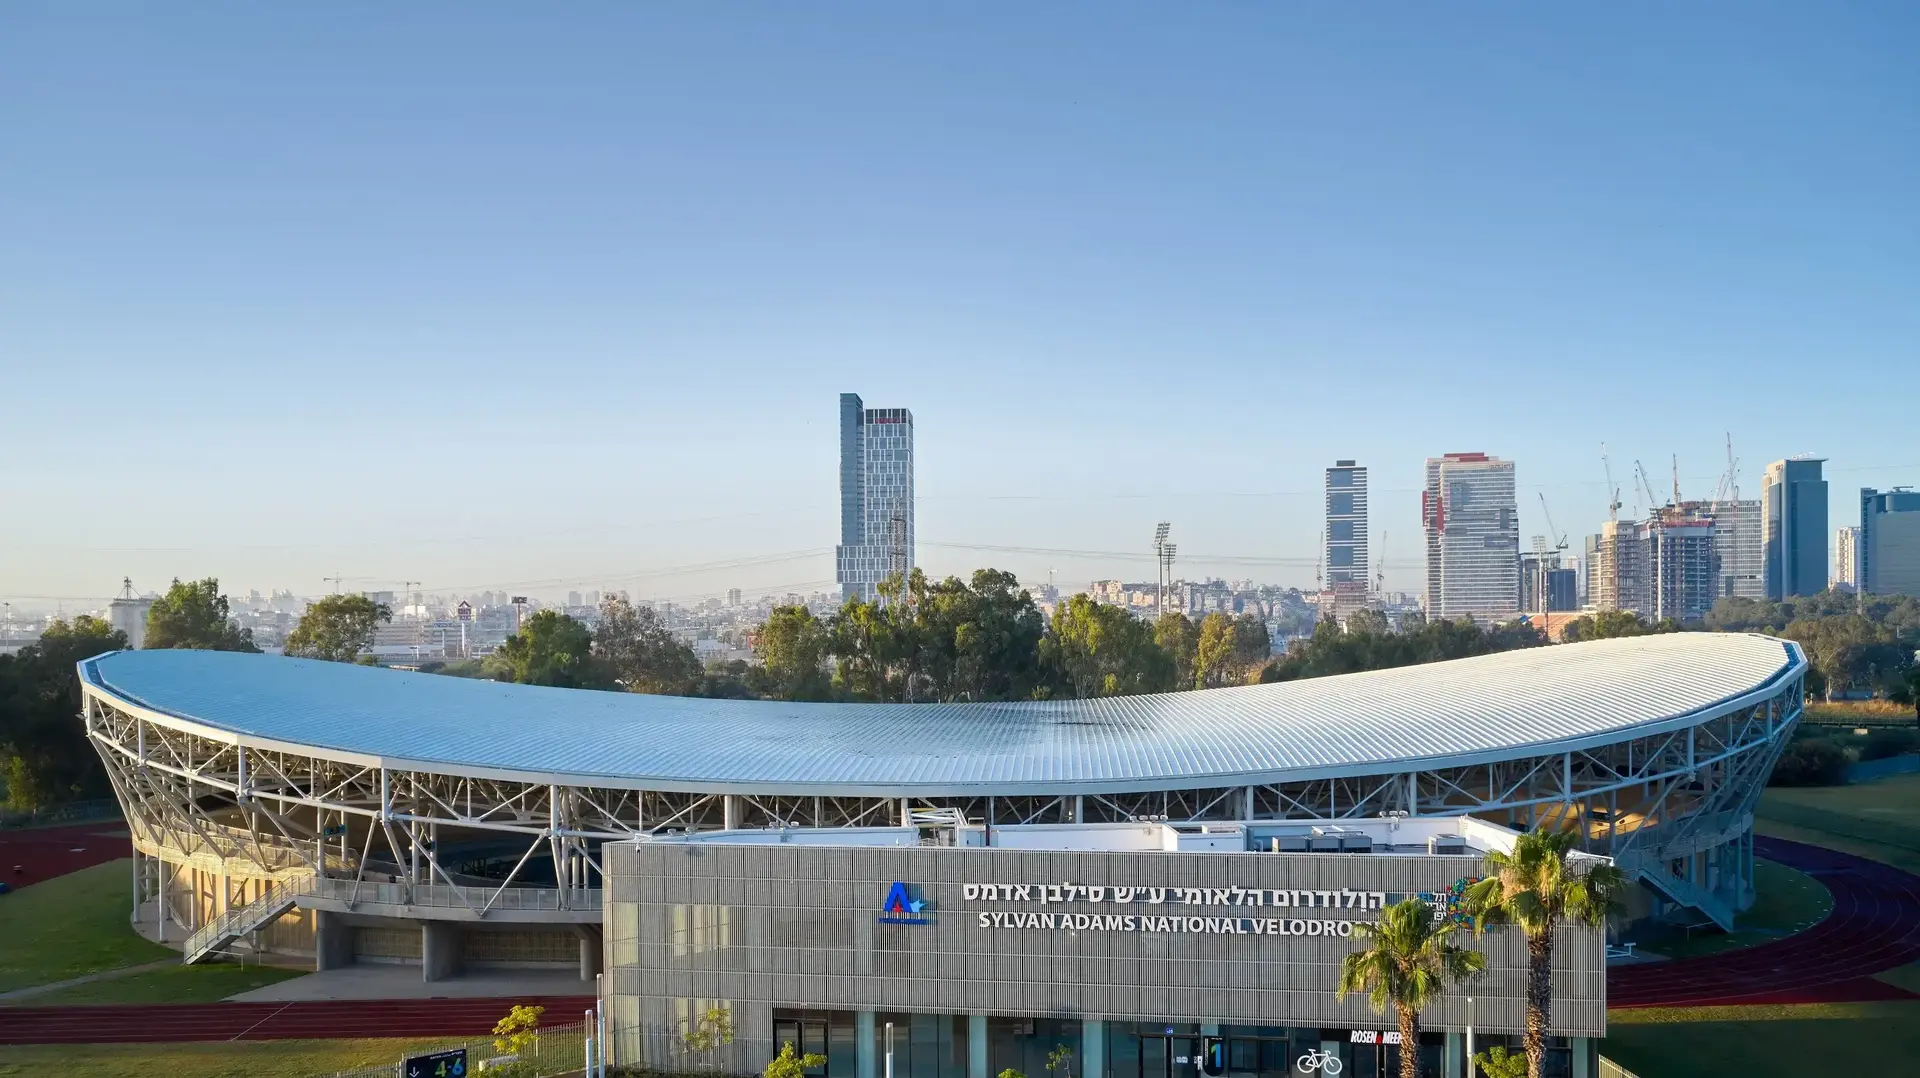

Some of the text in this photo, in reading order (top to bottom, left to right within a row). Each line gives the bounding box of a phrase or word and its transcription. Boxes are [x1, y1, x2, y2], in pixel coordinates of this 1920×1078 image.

[963, 884, 1030, 901] אדמס
[1038, 882, 1104, 904] סילבן
[1174, 885, 1263, 906] הלאומי
[979, 912, 1383, 937] SYLVAN ADAMS NATIONAL VELODRO
[1350, 1030, 1378, 1044] ROSEN
[1382, 1031, 1402, 1045] MEE
